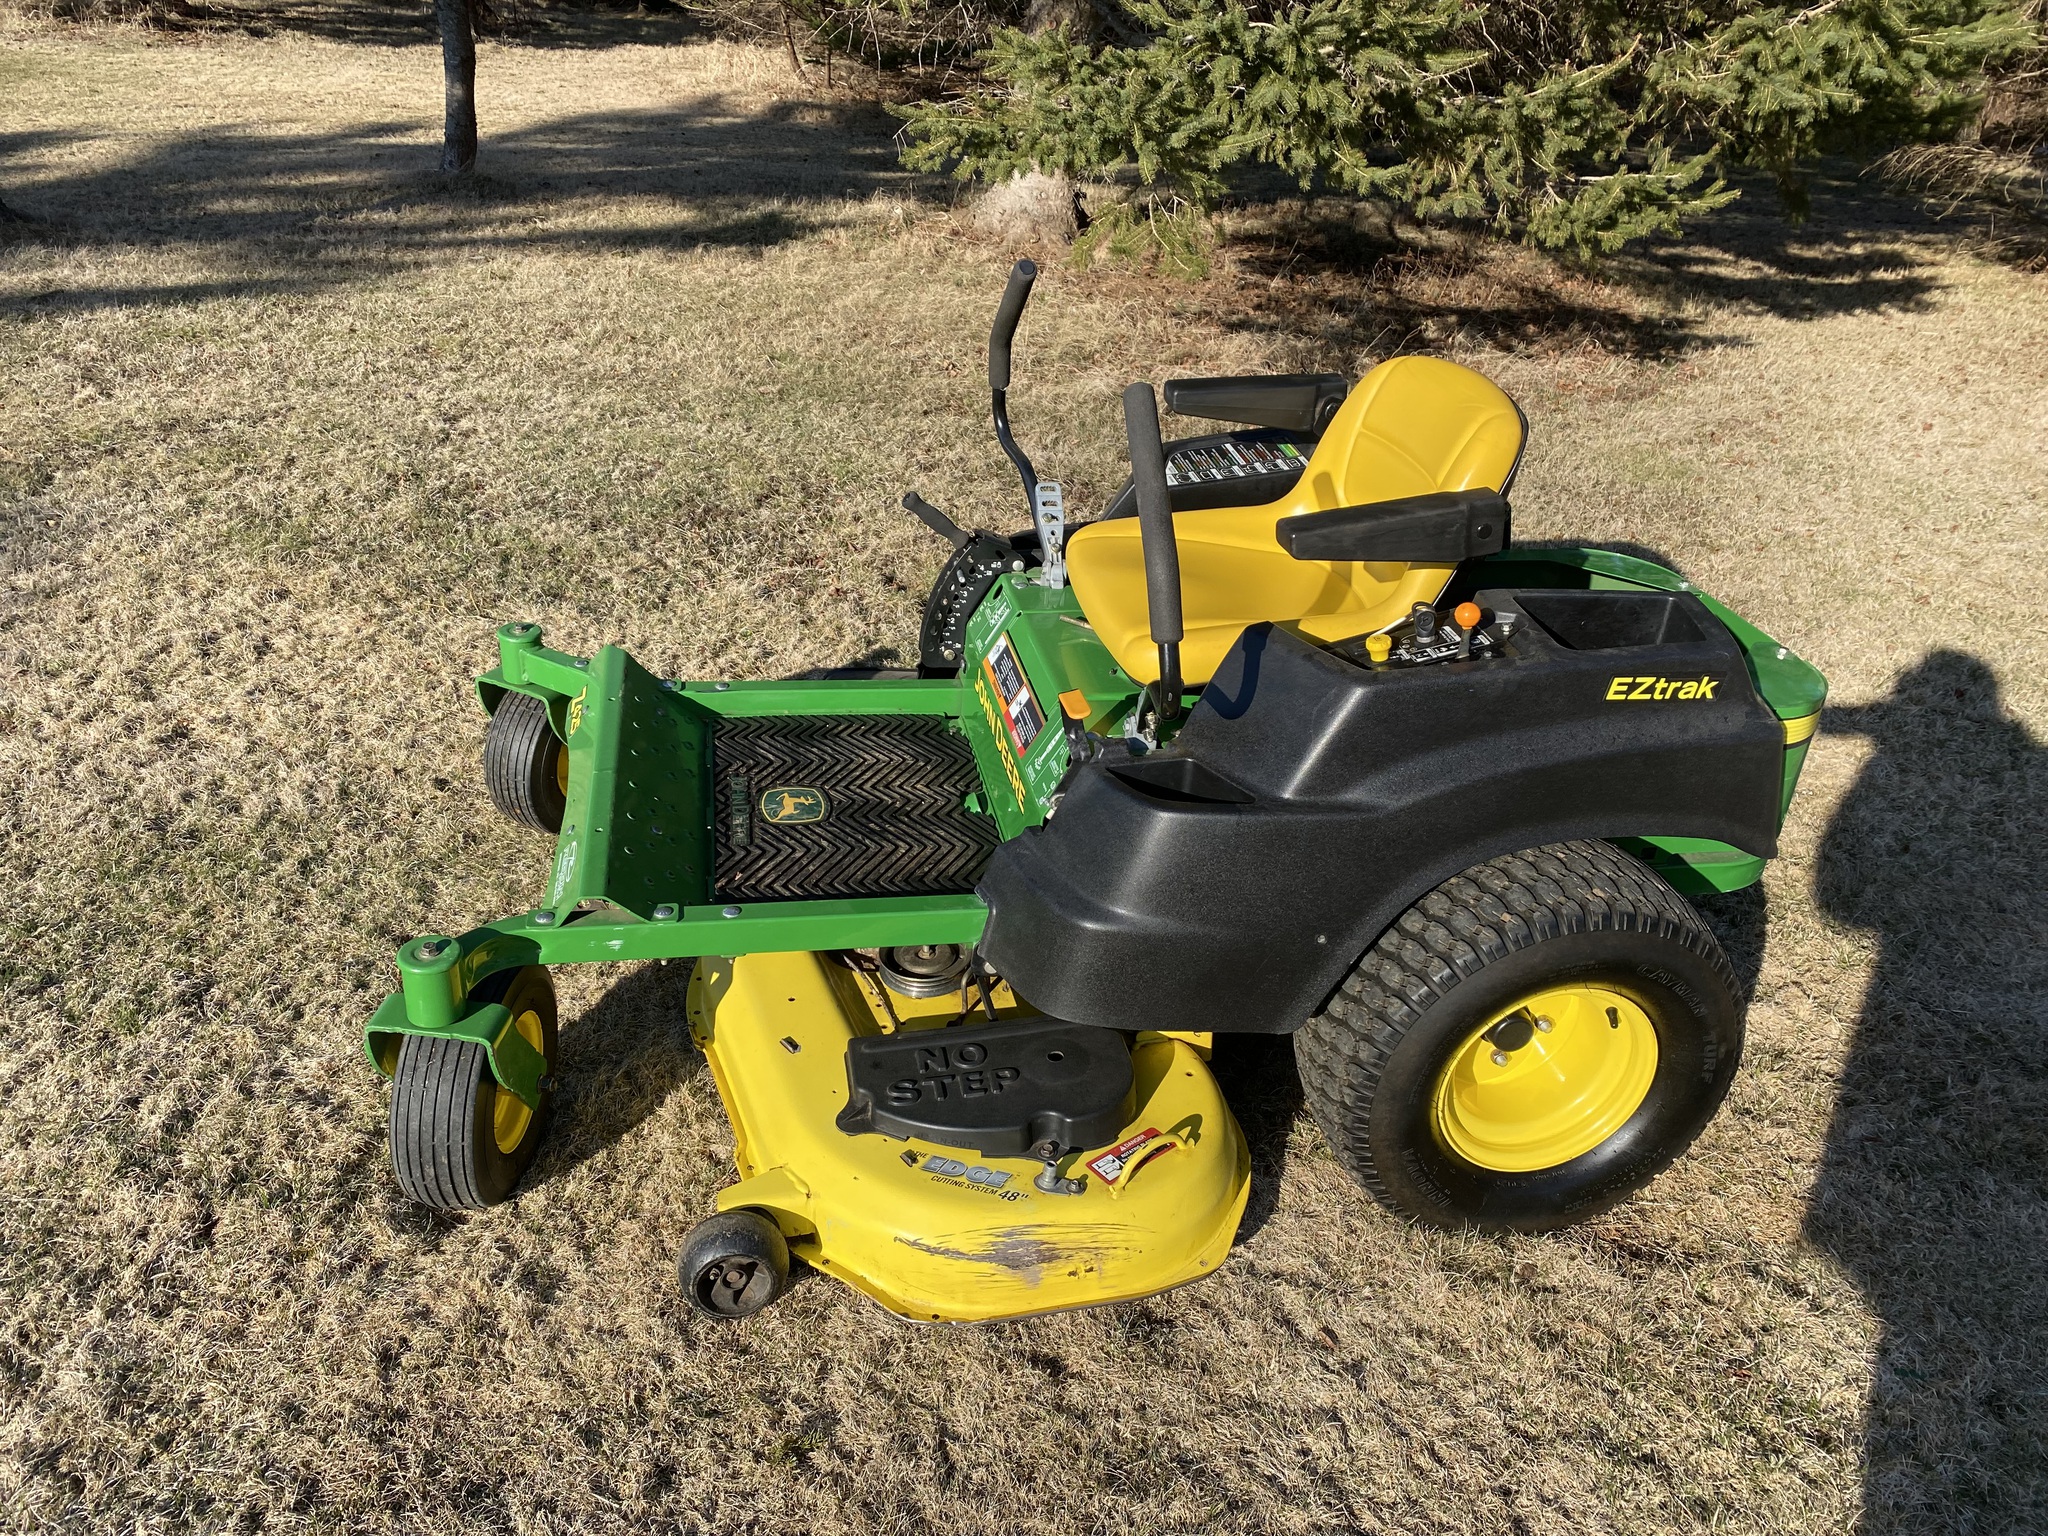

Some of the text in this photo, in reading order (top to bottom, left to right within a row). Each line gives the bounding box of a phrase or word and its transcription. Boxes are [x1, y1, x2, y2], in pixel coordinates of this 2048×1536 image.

[1605, 675, 1720, 701] EZtrak
[974, 667, 996, 737] JOHN
[994, 715, 1027, 816] DEERE
[730, 773, 749, 804] JOHN
[1637, 963, 1718, 1085] CAYMAN TURF
[915, 1042, 989, 1074] NO
[887, 1067, 1020, 1106] STEP
[914, 1151, 929, 1159] THE
[1123, 1134, 1147, 1149] DANGER
[919, 1155, 1013, 1188] EDGE
[930, 1175, 1029, 1202] CUTTING SYSTEM 48"
